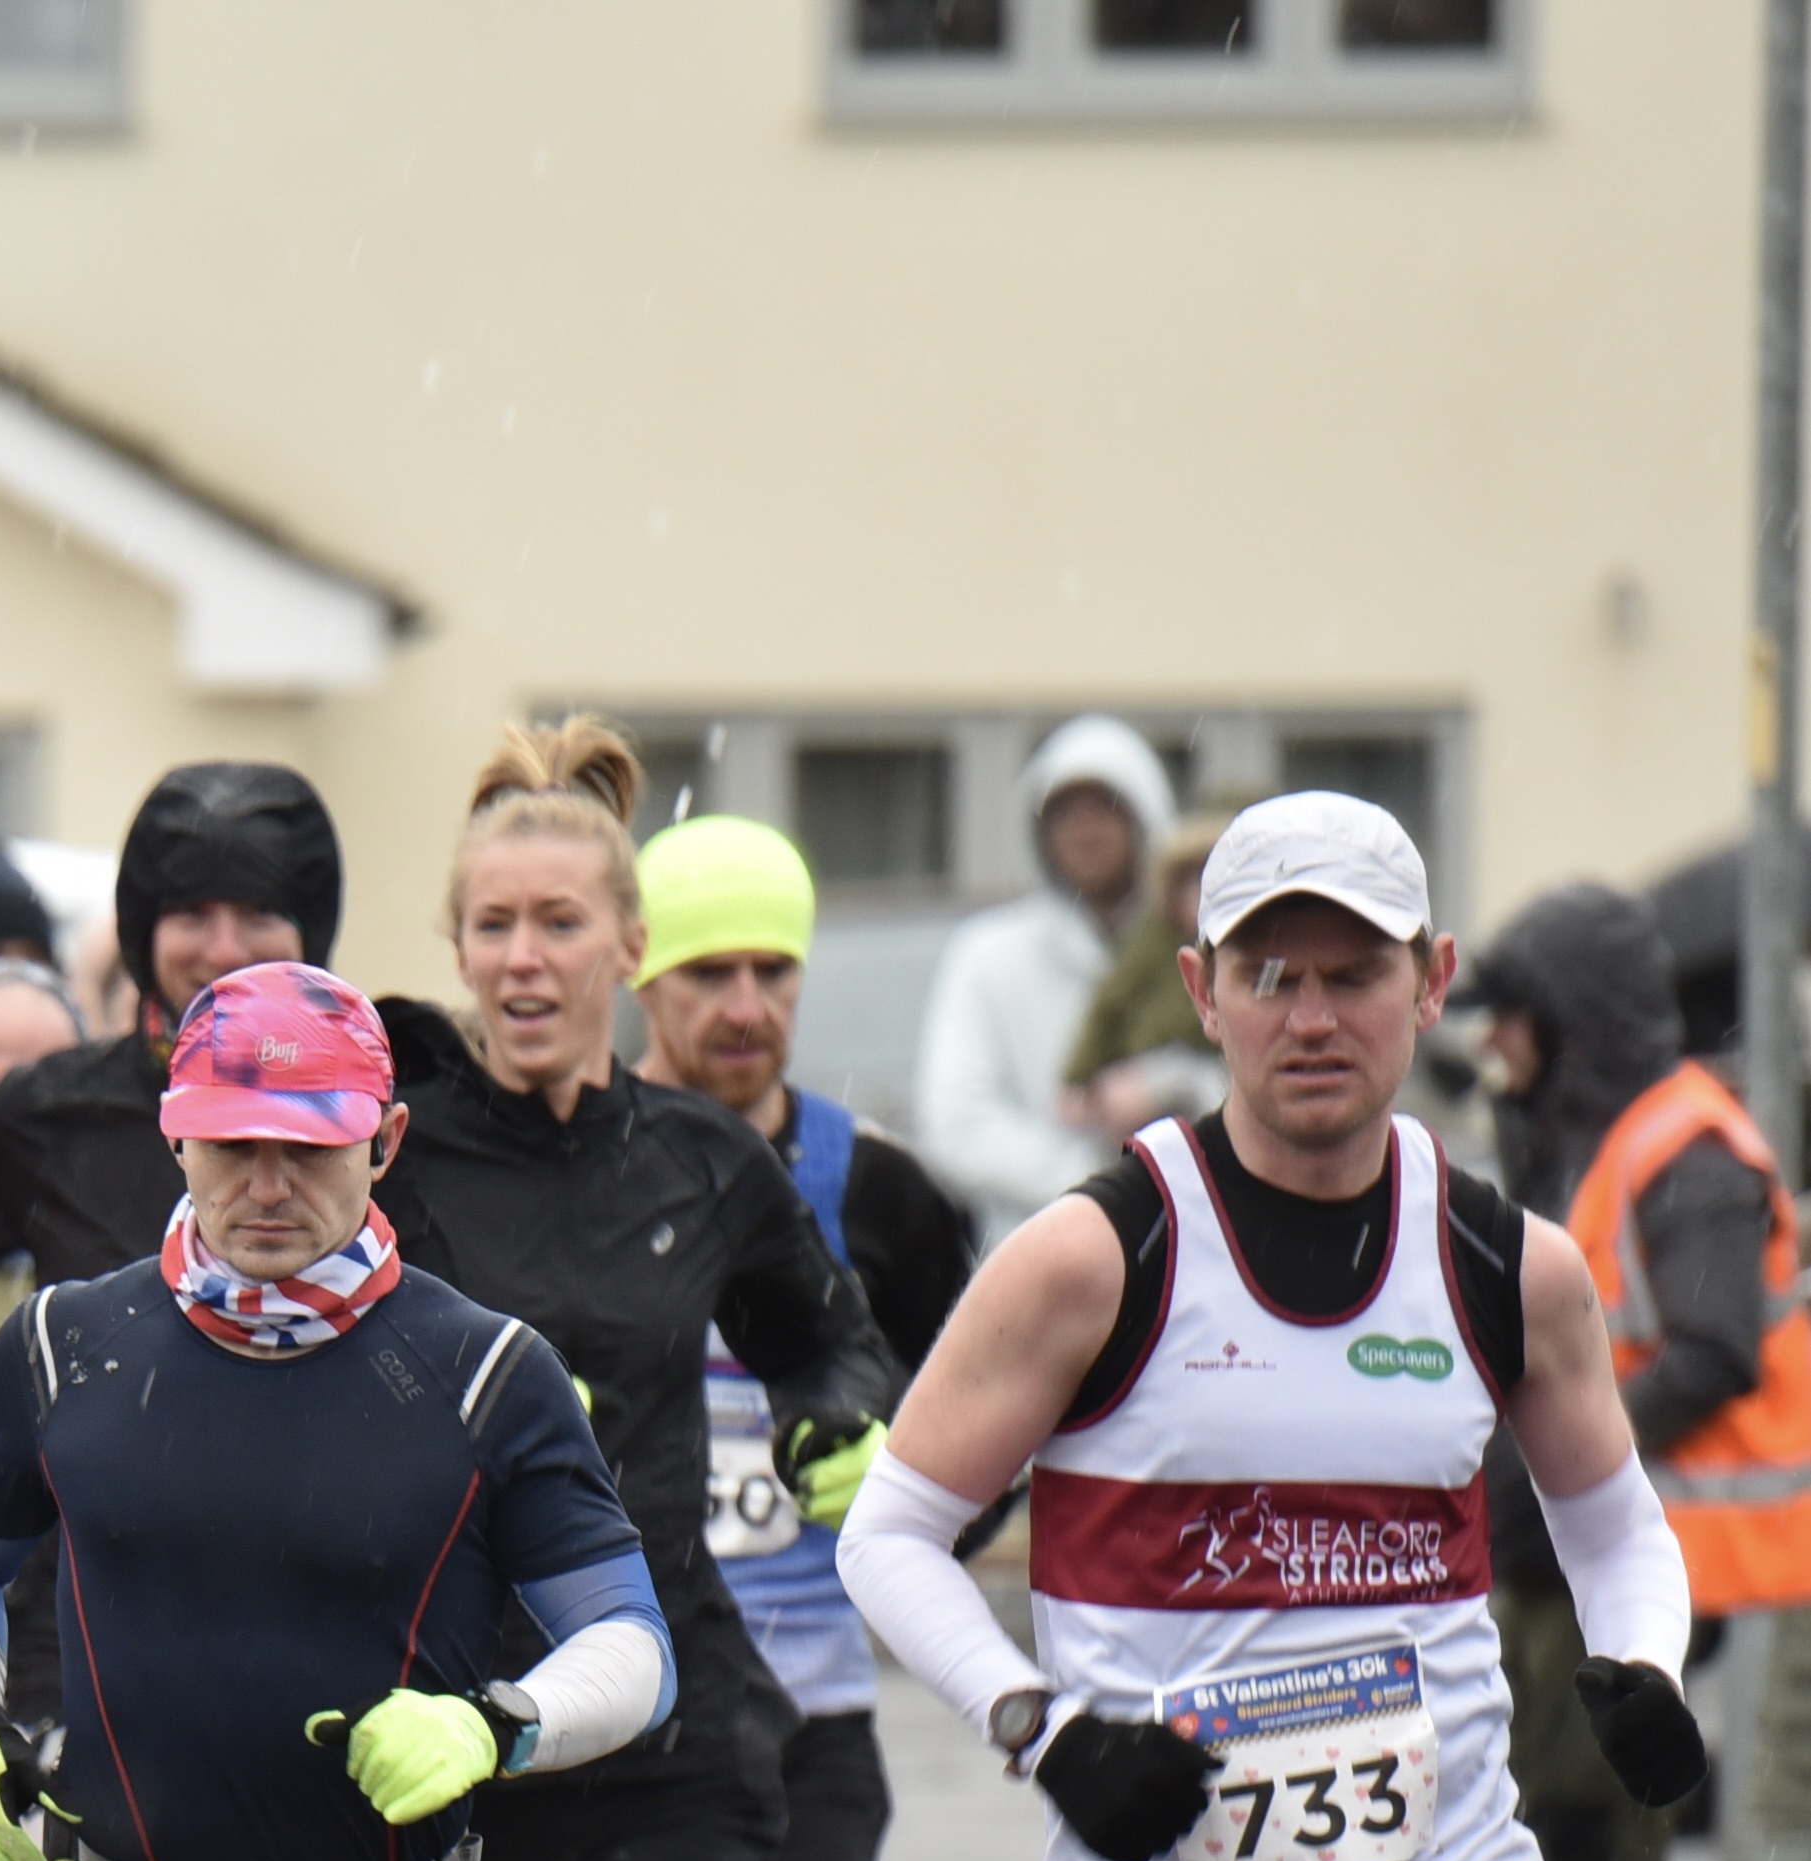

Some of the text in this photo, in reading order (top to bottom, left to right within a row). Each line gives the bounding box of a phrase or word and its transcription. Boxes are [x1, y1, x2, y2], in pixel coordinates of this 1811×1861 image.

[1358, 1343, 1447, 1372] Specsavers
[1272, 1518, 1442, 1557] SLEAFORD
[1287, 1552, 1448, 1587] STRIDERS
[1193, 1653, 1388, 1711] St Valentine's 30k
[1219, 1755, 1407, 1861] 733
